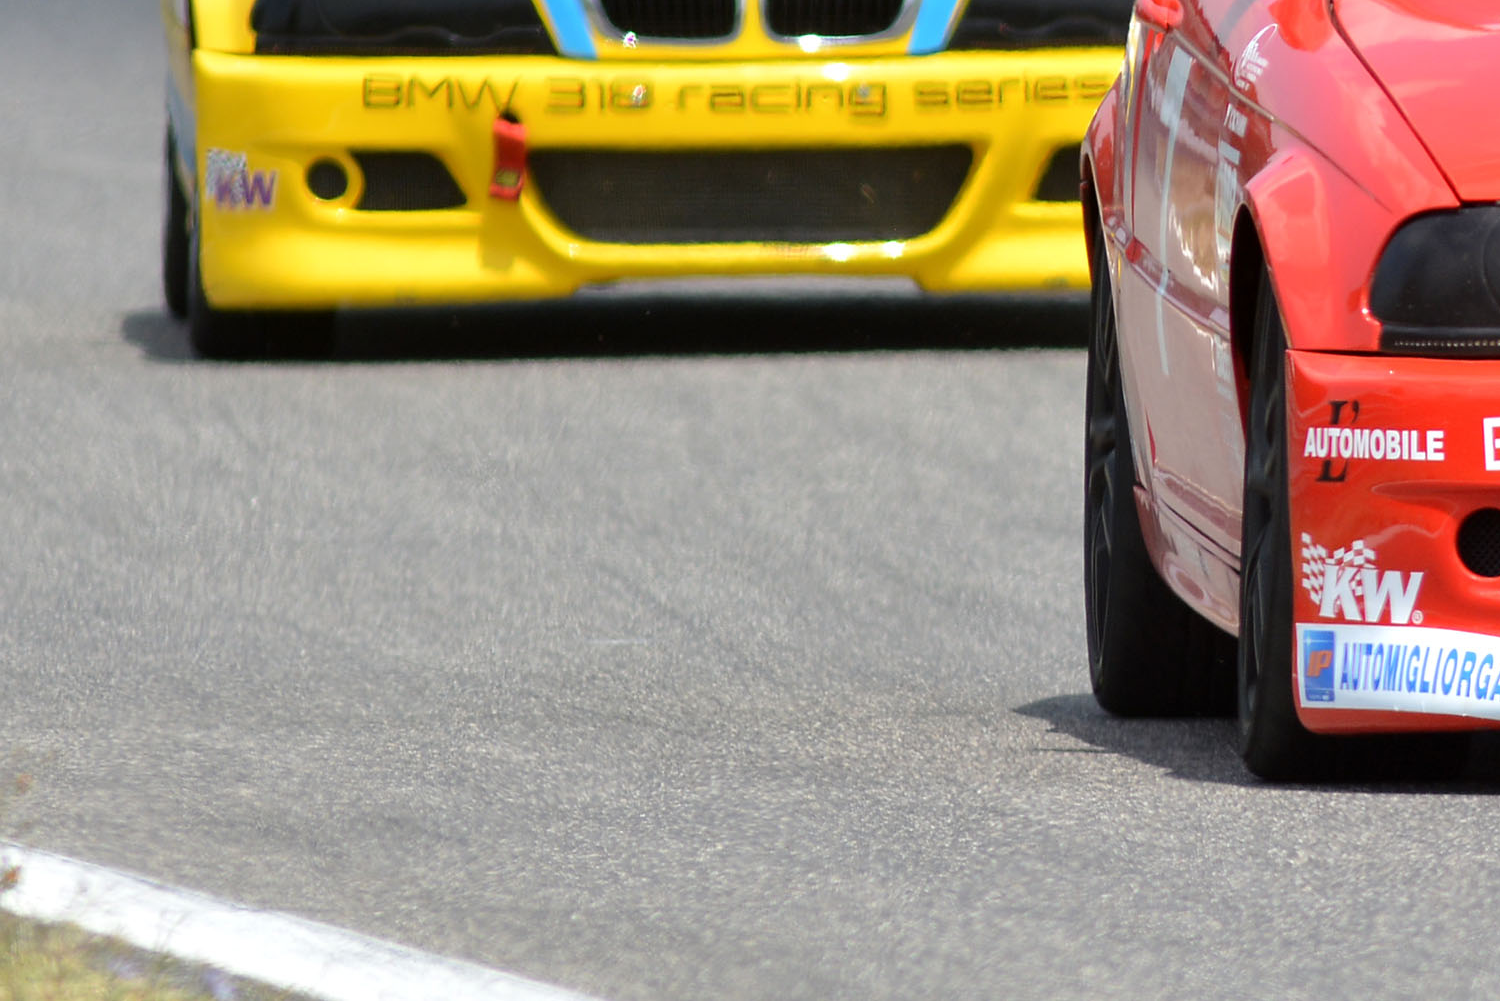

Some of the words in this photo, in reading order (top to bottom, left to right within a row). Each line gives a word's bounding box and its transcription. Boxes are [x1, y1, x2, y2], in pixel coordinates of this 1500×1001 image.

[362, 76, 522, 111] BMW
[544, 77, 652, 111] 318
[677, 81, 888, 118] racing
[914, 74, 1110, 109] series
[1304, 427, 1446, 461] AUTOMOBILE
[1319, 564, 1425, 625] KW
